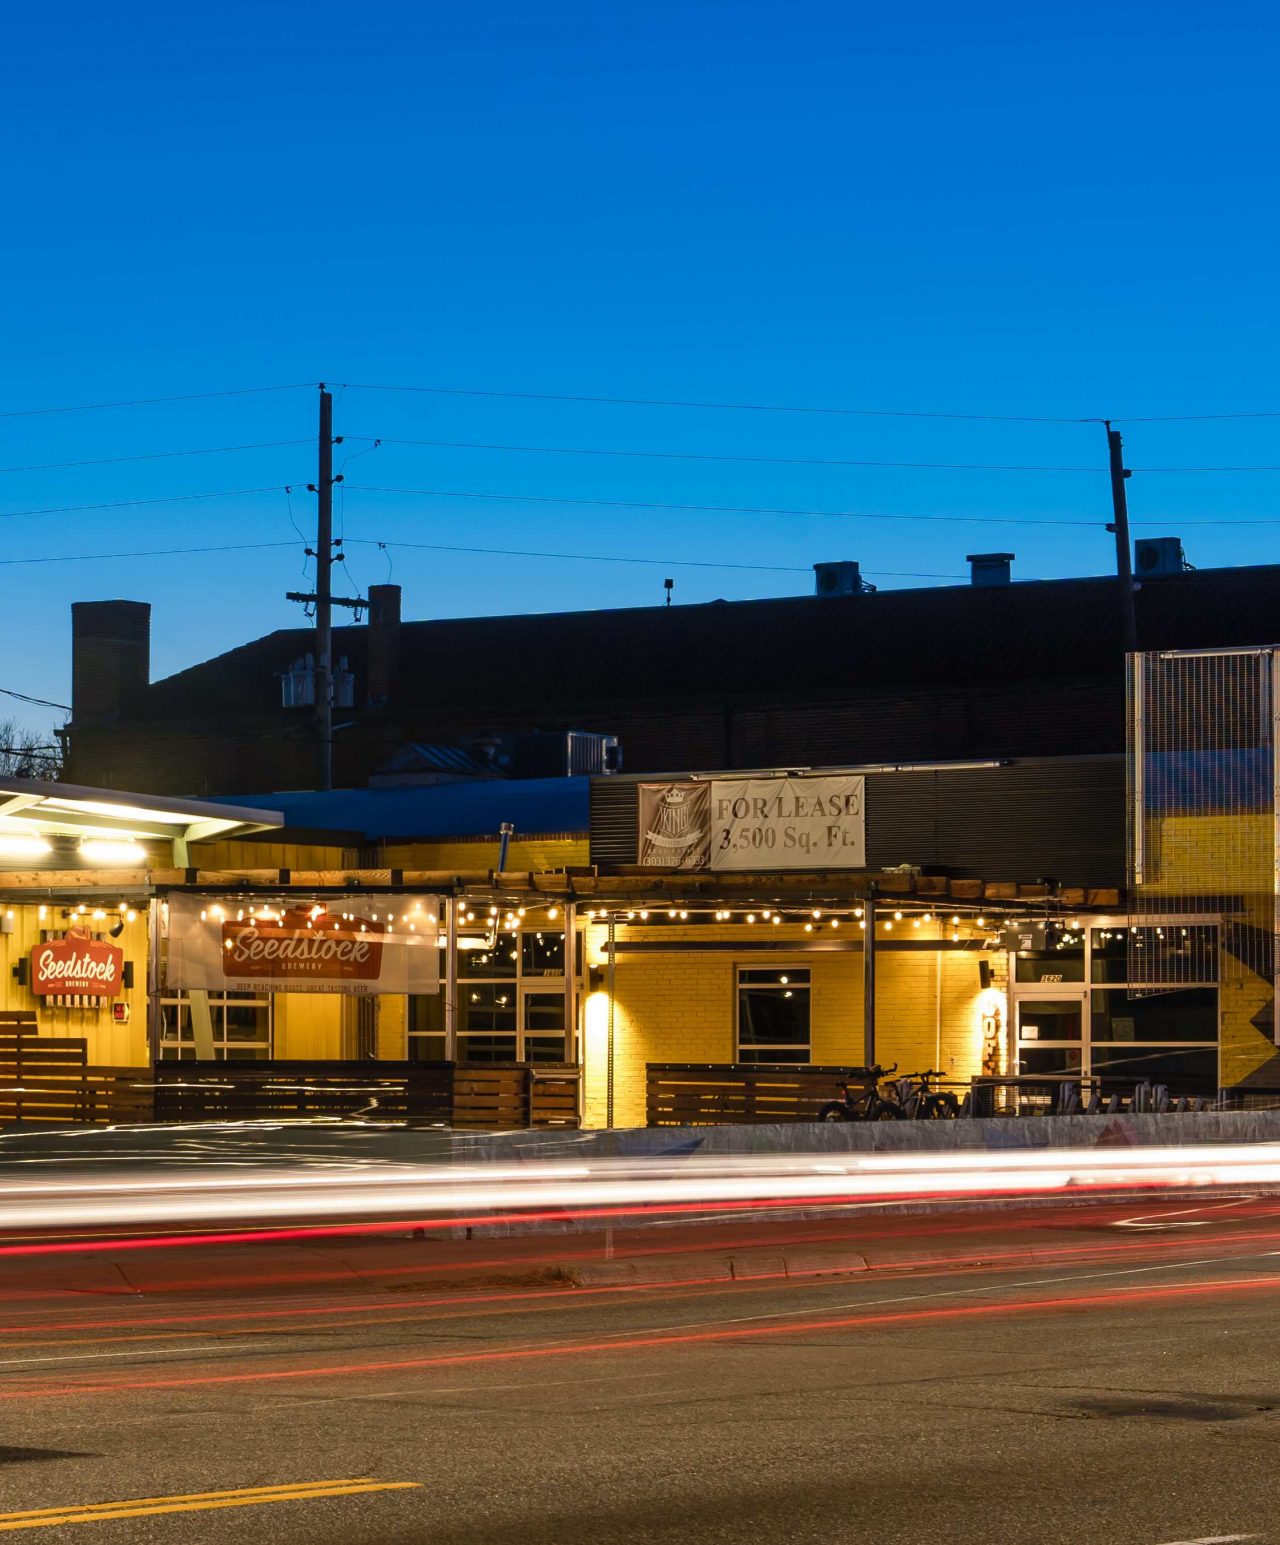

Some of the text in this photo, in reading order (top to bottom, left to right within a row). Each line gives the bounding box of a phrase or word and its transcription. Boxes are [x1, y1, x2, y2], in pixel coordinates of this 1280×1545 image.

[717, 794, 859, 820] FOR LEASE
[720, 825, 856, 854] 3,500 Sq. Ft.
[234, 927, 370, 962] Seedstock
[39, 950, 115, 981] Seedstock
[281, 962, 322, 970] BREWERY
[1041, 974, 1062, 982] 3620
